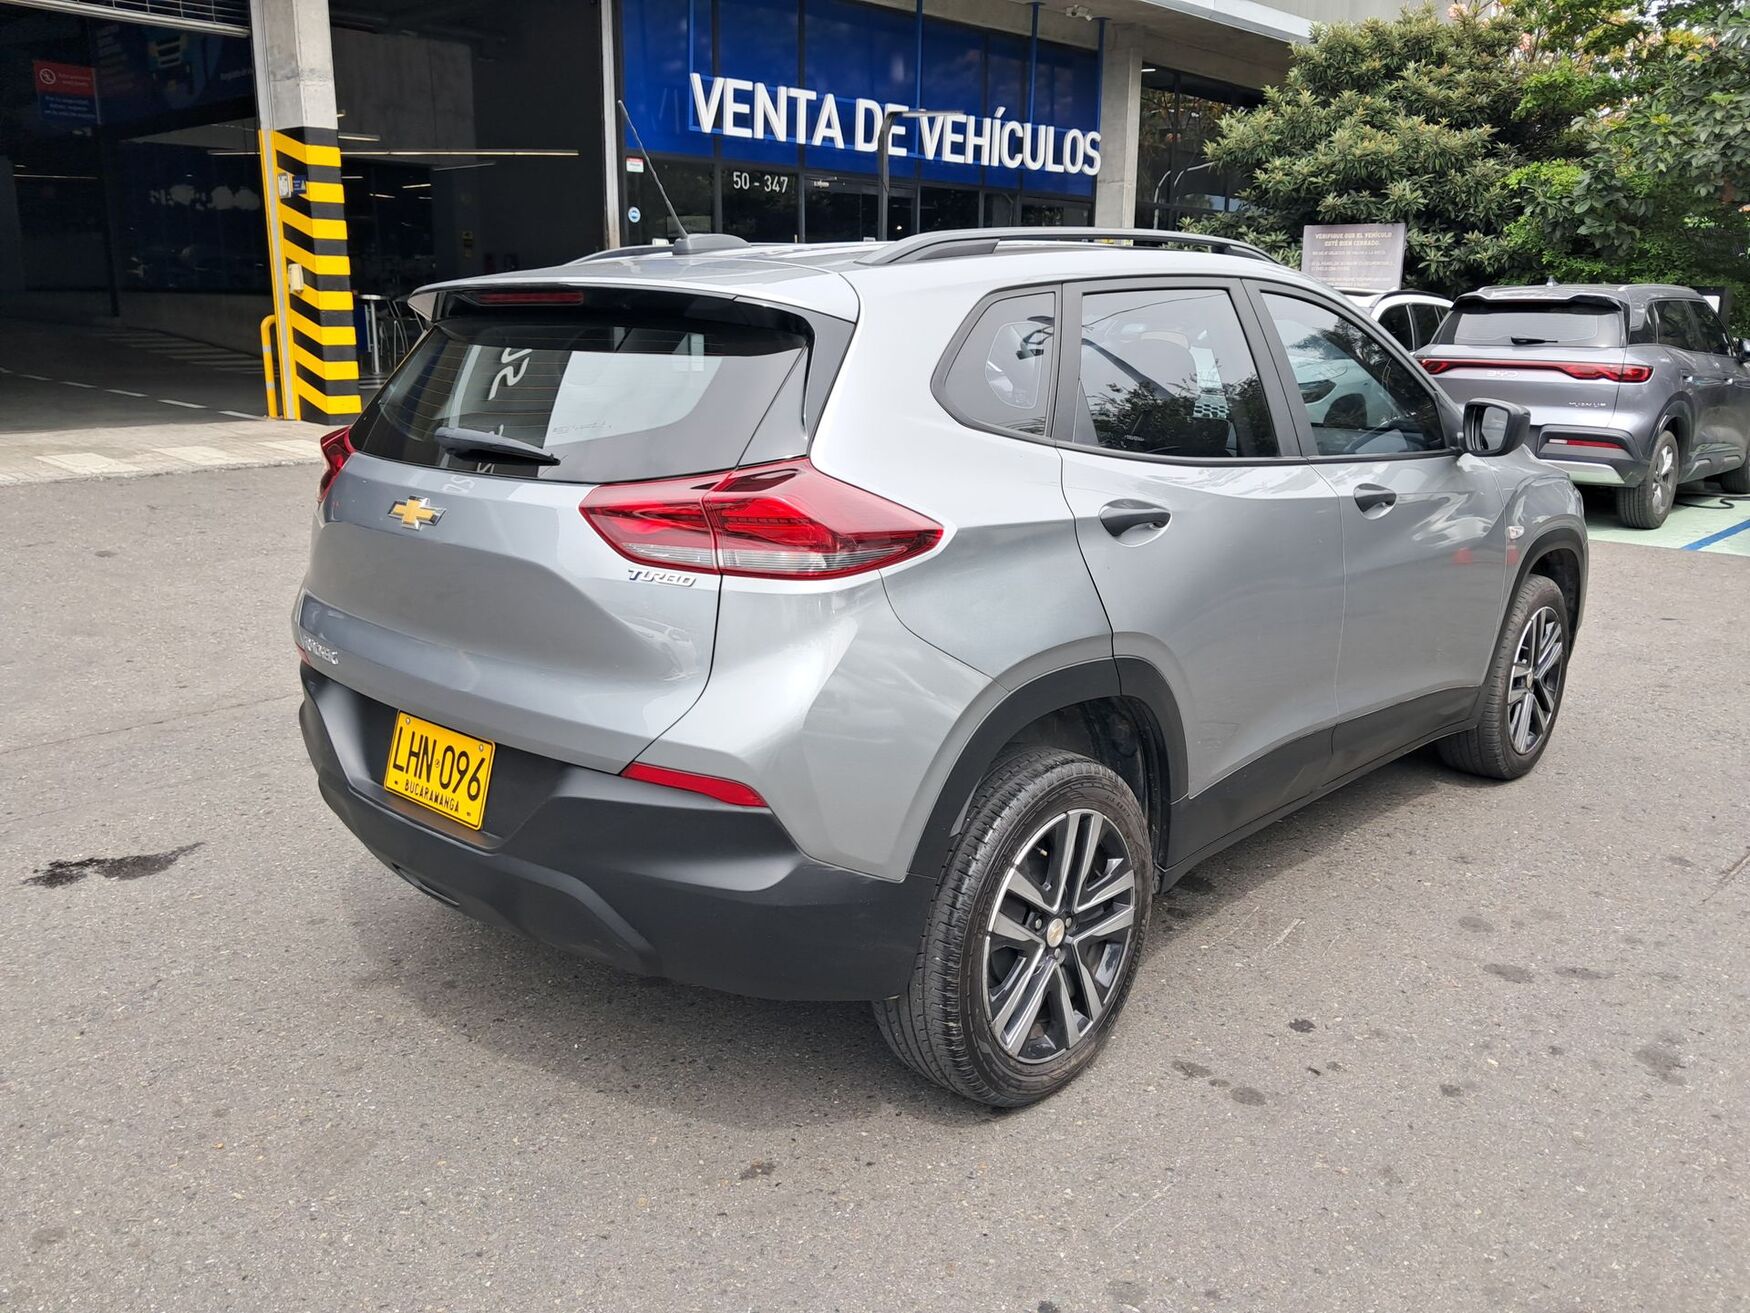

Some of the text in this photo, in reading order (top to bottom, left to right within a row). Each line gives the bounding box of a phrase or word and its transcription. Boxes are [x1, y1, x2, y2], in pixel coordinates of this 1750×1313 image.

[690, 72, 1100, 175] VENTA DE VEHÍCULOS
[733, 171, 750, 190] 50
[764, 174, 788, 193] 347
[628, 568, 697, 587] TURBO
[392, 726, 486, 801] LHN 096
[404, 779, 460, 813] BUCARAMANGA
